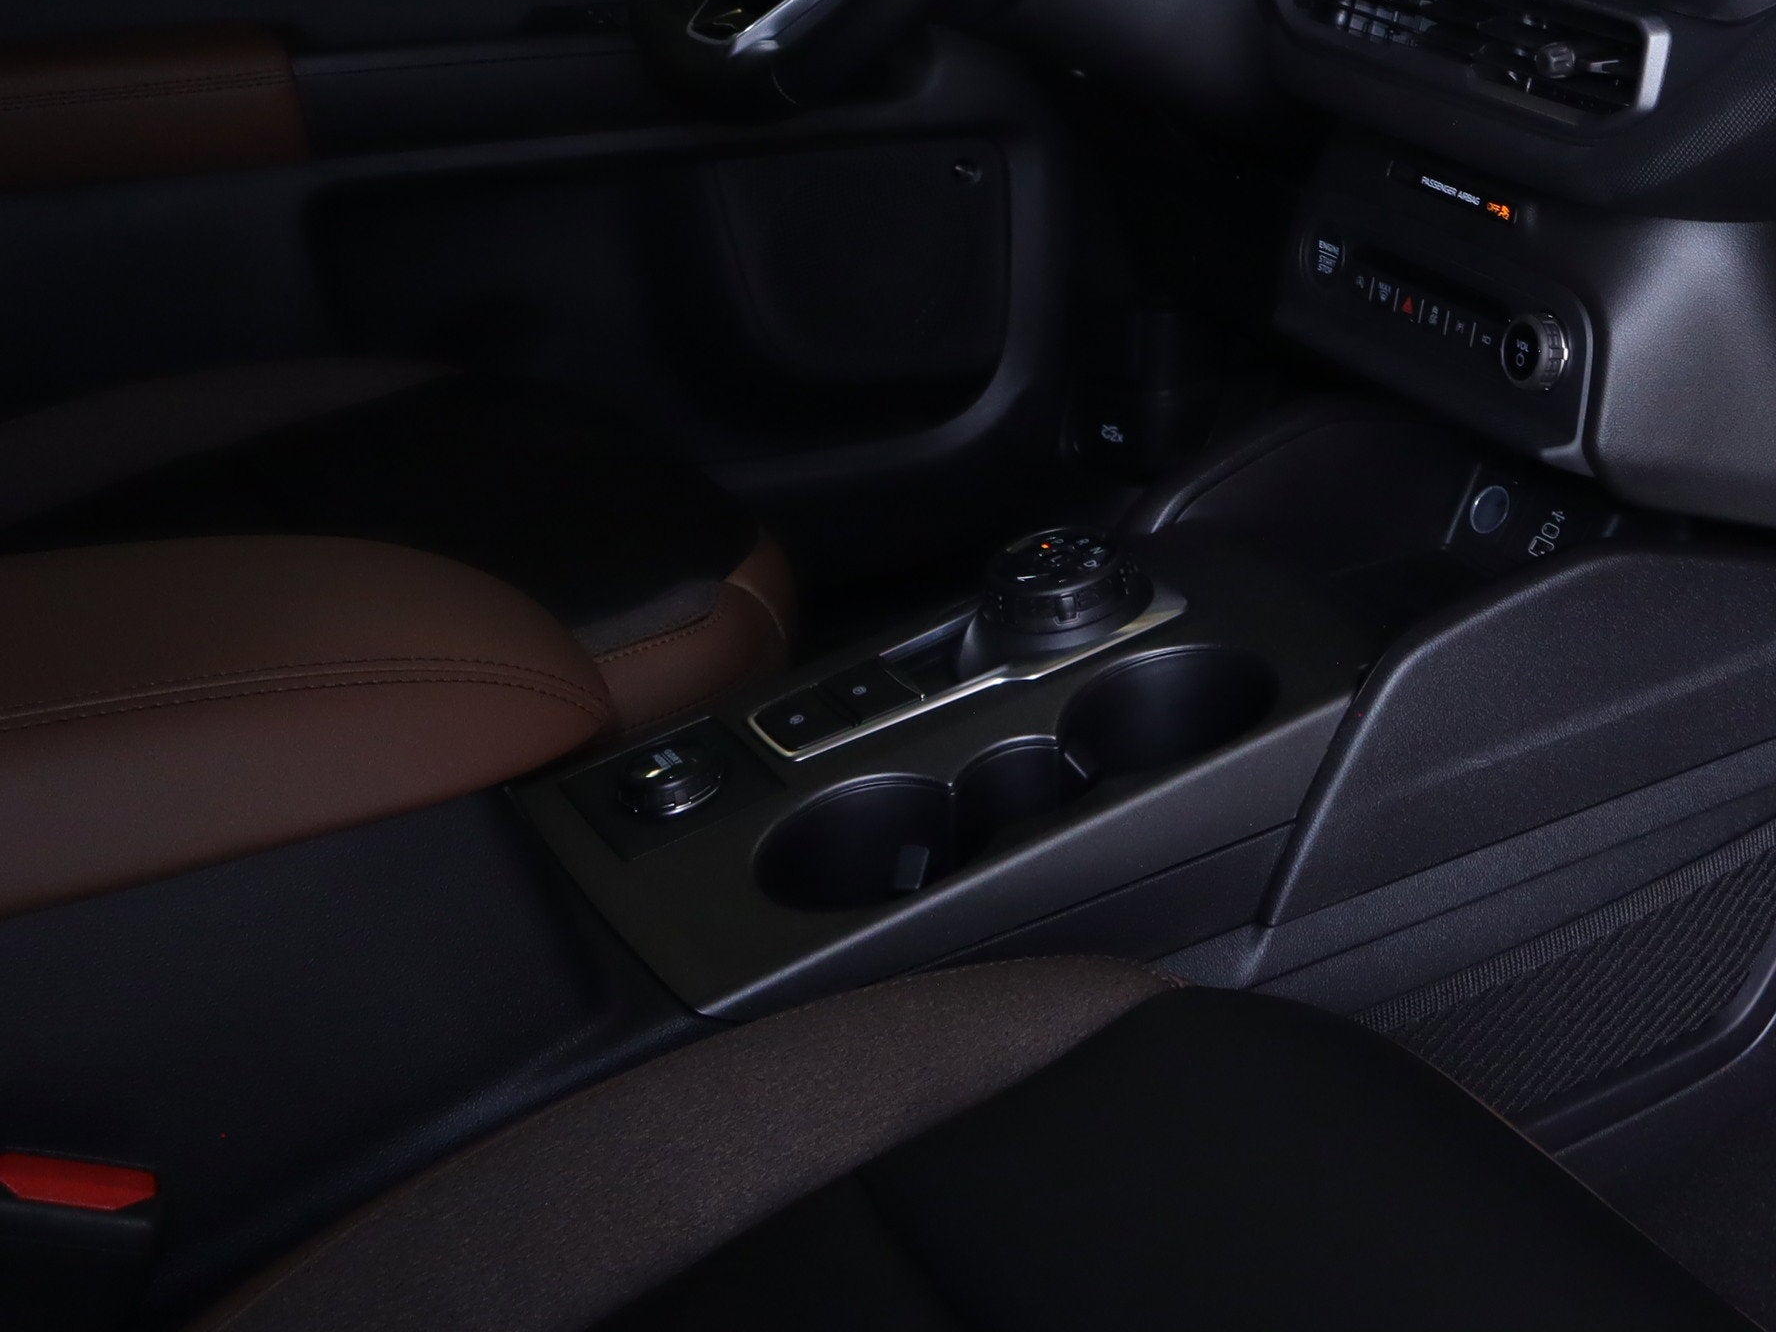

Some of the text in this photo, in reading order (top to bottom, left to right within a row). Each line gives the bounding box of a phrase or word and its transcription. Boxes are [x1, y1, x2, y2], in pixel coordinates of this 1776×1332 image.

[1421, 176, 1458, 197] PASSENGER
[1457, 190, 1480, 206] AIRBAG
[1516, 338, 1529, 352] VOL
